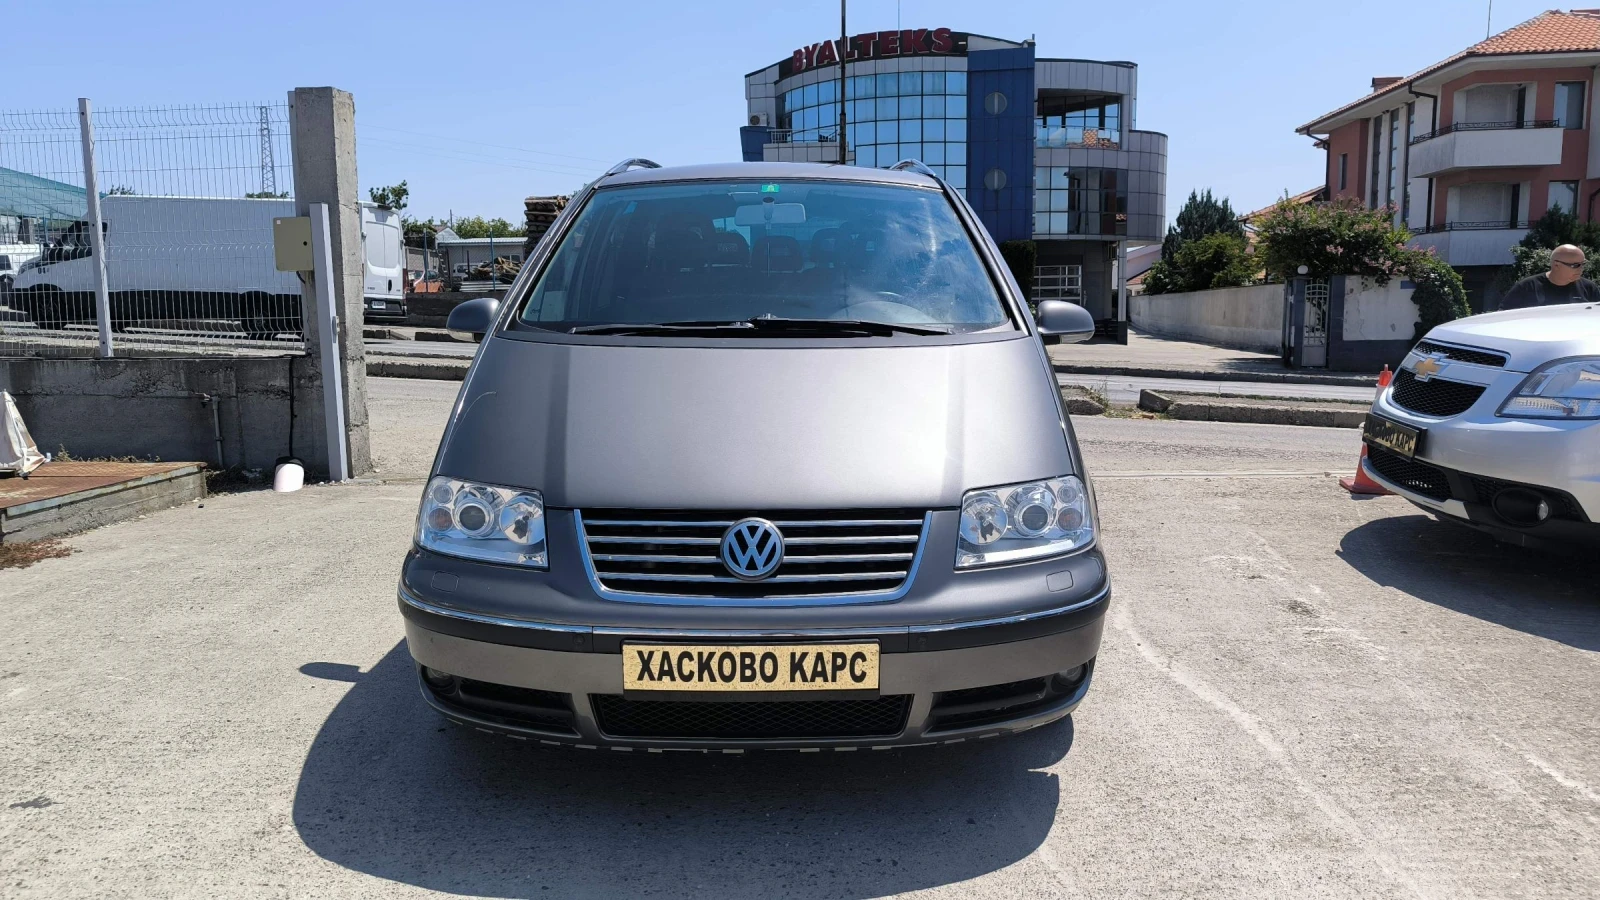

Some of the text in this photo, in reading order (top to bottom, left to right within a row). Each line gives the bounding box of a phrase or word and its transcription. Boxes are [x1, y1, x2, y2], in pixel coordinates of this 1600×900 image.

[792, 27, 954, 73] BYALTEKS
[722, 519, 783, 577] VW
[636, 650, 867, 683] ХАСКОВО КАРС
